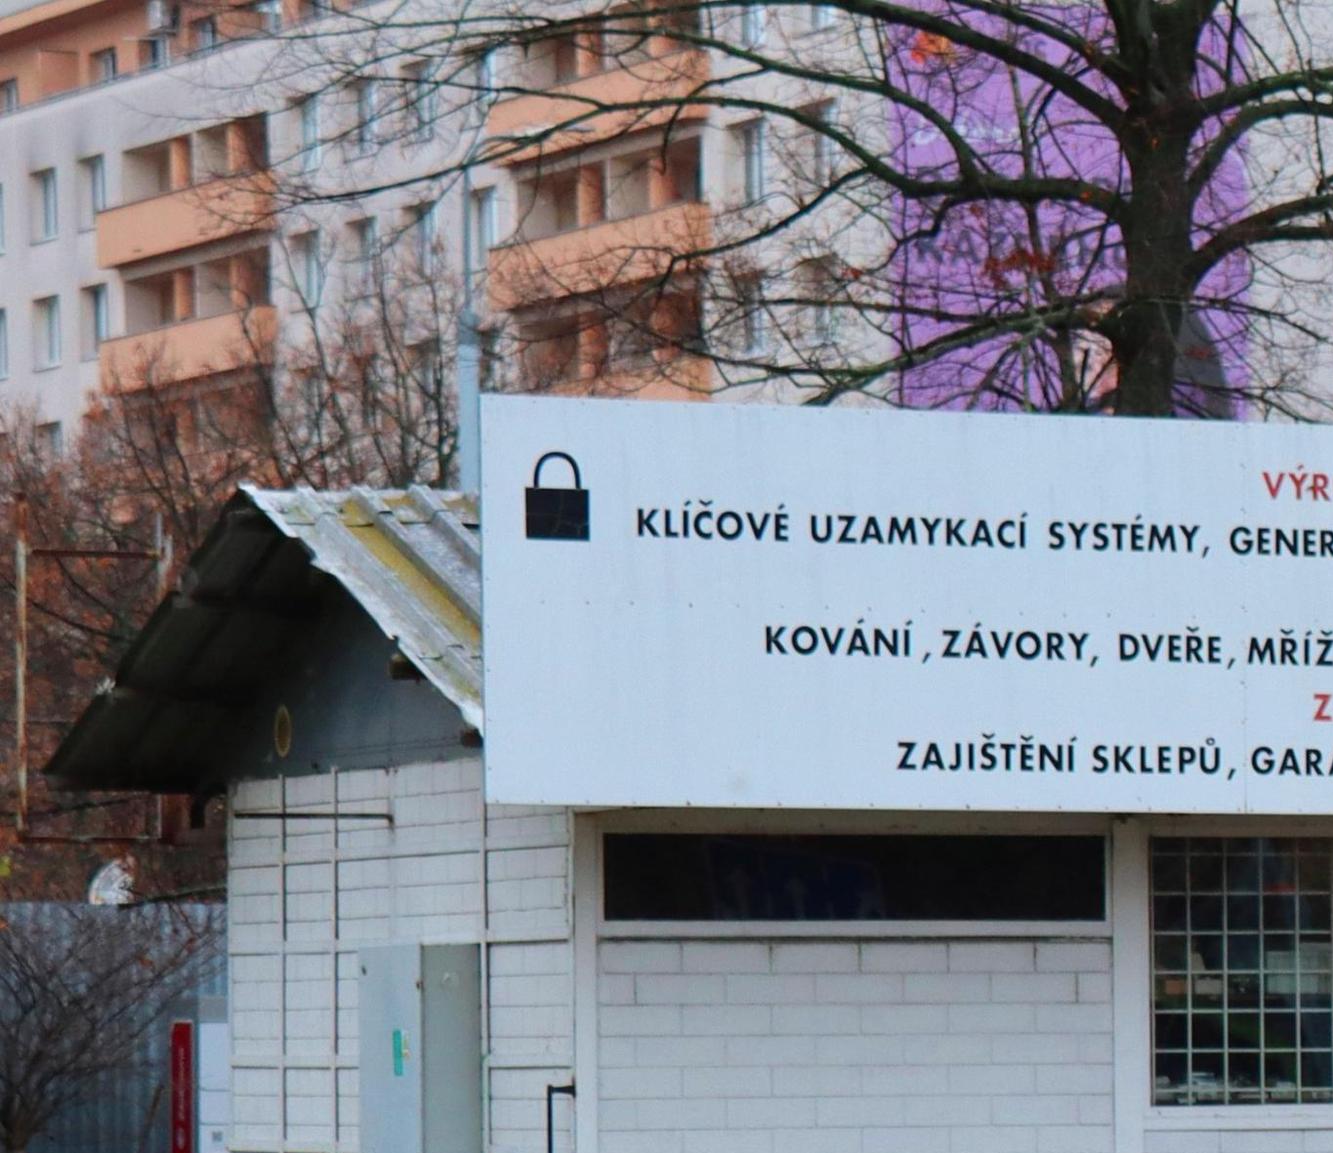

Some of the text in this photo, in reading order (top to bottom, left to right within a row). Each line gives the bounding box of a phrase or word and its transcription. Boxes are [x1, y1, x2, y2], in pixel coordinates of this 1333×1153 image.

[636, 499, 789, 543] KLÍČOVÉ
[810, 511, 1028, 550] UZAMYKACÍ
[1048, 514, 1210, 558] SYSTÉMY,
[1118, 625, 1236, 670] DVEŘE,
[896, 732, 1077, 773] ZAJIŠTĚNÍ
[1091, 737, 1236, 781] SKLEPŮ,
